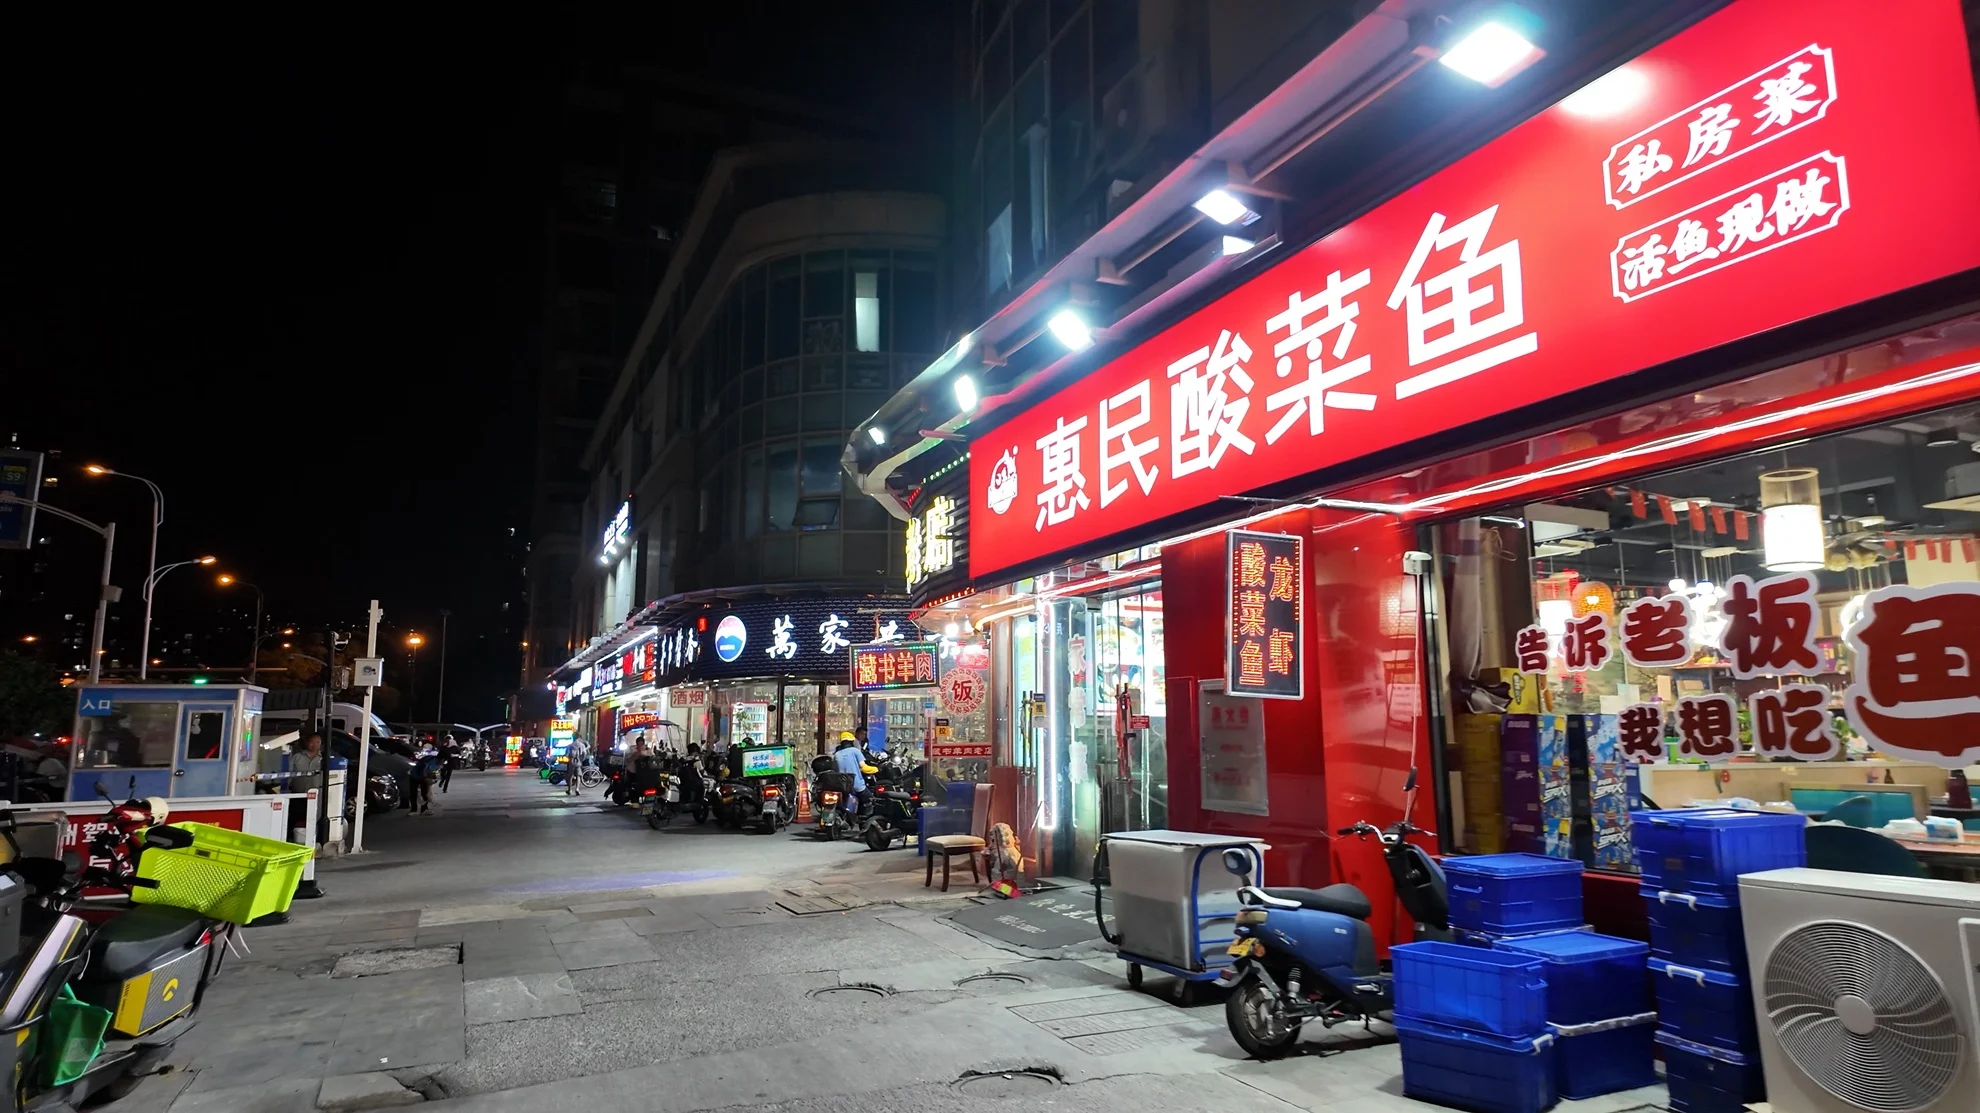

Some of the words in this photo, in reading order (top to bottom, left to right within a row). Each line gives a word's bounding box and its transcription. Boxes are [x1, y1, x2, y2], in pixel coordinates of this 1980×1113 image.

[1615, 62, 1822, 195] 私房菜
[1619, 168, 1837, 291] 活鱼现做
[1035, 204, 1539, 531] 惠民酸菜鱼
[858, 650, 935, 685] 藏书羊肉
[1239, 541, 1267, 686] 酸菜鱼
[1268, 555, 1294, 675] 龙虾
[1517, 577, 1819, 673] 告诉老板
[82, 698, 111, 710] 入口
[673, 690, 704, 705] 酒烟
[951, 679, 974, 703] 饭
[1619, 687, 1833, 756] 我想吃
[1856, 592, 1980, 757] 鱼
